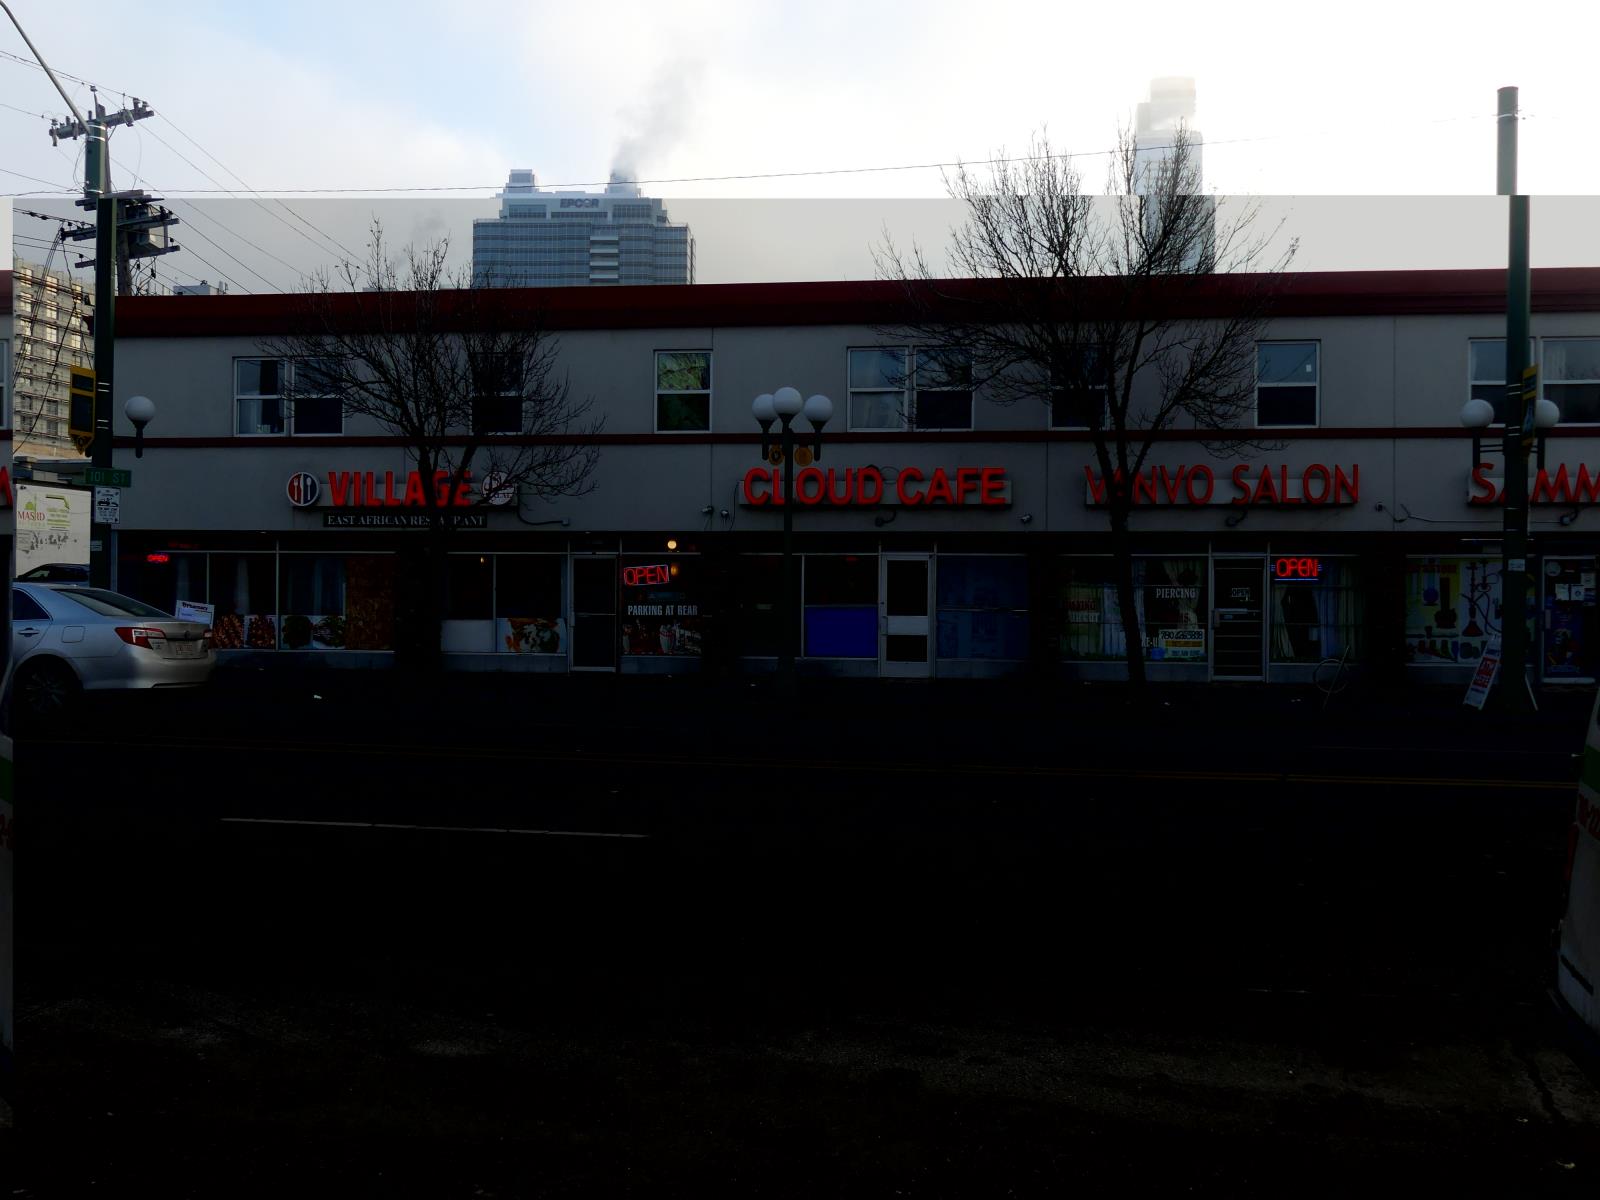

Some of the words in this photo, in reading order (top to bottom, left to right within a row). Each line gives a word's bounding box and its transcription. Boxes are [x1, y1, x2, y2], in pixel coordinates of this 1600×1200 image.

[91, 471, 105, 482] 101
[112, 472, 127, 483] ST
[1231, 464, 1359, 506] SALON
[1471, 463, 1600, 507] SMM
[327, 471, 473, 508] VILLAGE
[743, 467, 883, 507] CLOUD
[895, 467, 1006, 506] CAFE
[327, 515, 355, 526] EAST
[358, 515, 407, 526] AFRICAN
[409, 515, 484, 526] RESARANT
[624, 566, 668, 586] OPEN
[1276, 558, 1319, 577] OPEN
[1156, 588, 1196, 599] PIERCING
[627, 605, 663, 616] PARKING
[665, 605, 675, 616] AT
[677, 605, 698, 616] REAR
